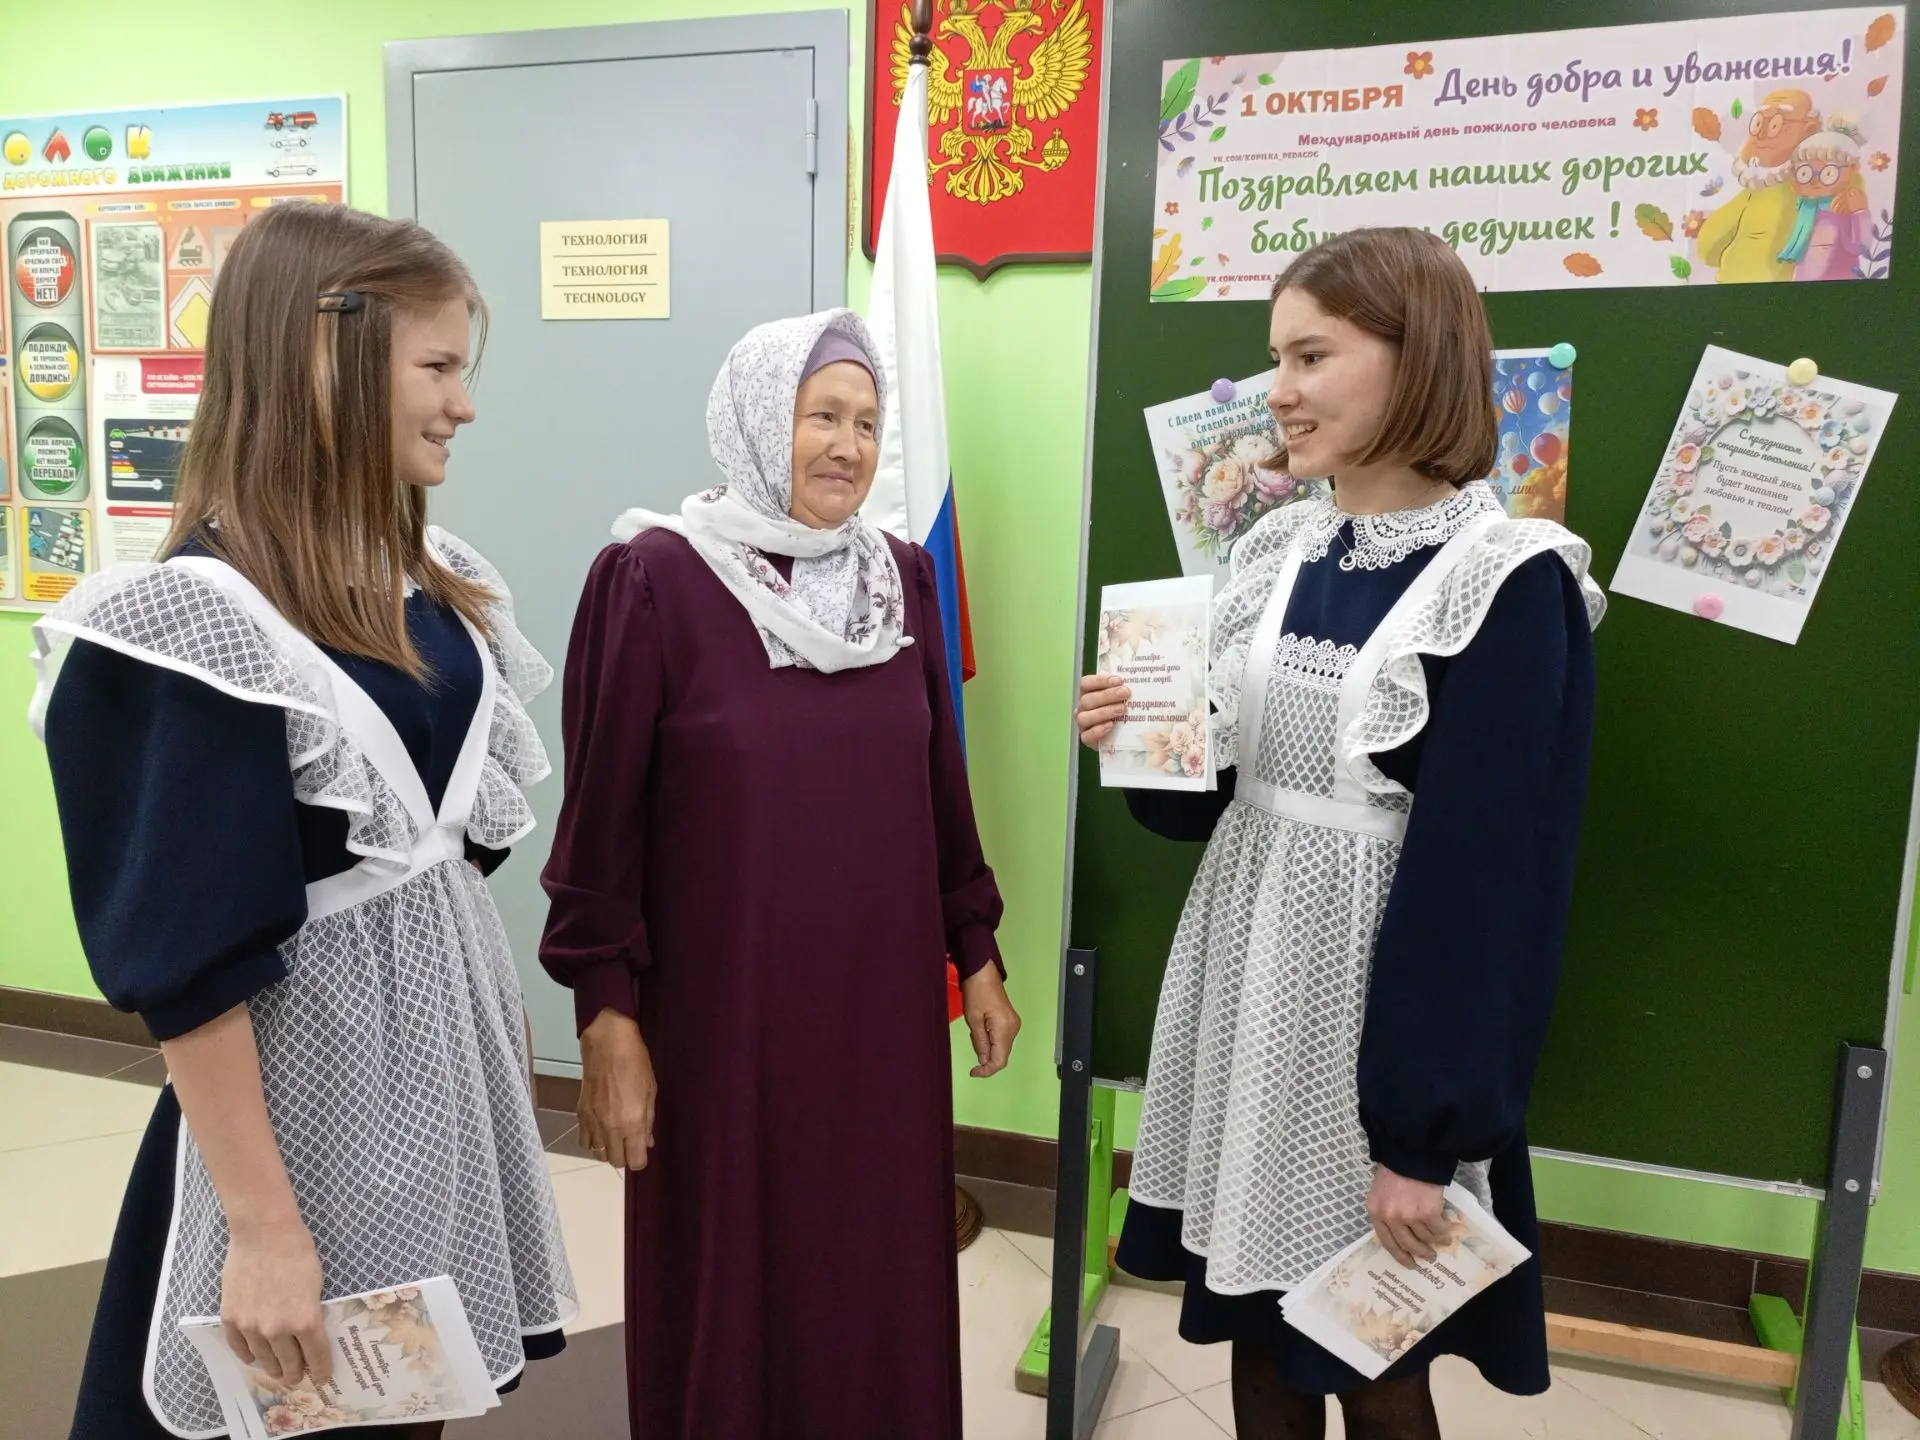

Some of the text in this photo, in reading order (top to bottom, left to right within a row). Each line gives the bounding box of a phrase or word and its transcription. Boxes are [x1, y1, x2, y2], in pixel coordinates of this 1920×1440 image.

[1434, 38, 1852, 108] День добра и уважения!
[1241, 84, 1404, 118] 1 ОКТЯБРЯ
[1297, 116, 1617, 148] Международный день пожилого человека
[3, 161, 231, 190] ДОРОЖНОГО ДВИЖЕНИЯ
[1197, 149, 1710, 212] Поздравляем наших дорогих
[562, 233, 648, 246] ТЕХНОЛОГИЯ
[1442, 217, 1596, 257] дедушек
[562, 264, 648, 277] ТЕХНОЛОГИЯ
[36, 287, 57, 300] НЕТ!
[564, 292, 647, 304] TECHNOLOGY
[1205, 396, 1253, 418] пожилых
[1196, 416, 1234, 434] Спасибо
[1739, 428, 1749, 440] С
[1713, 459, 1803, 492] Пусть каждый день
[1716, 473, 1789, 502] будет наполнен
[1703, 486, 1794, 517] любовью и теплом!
